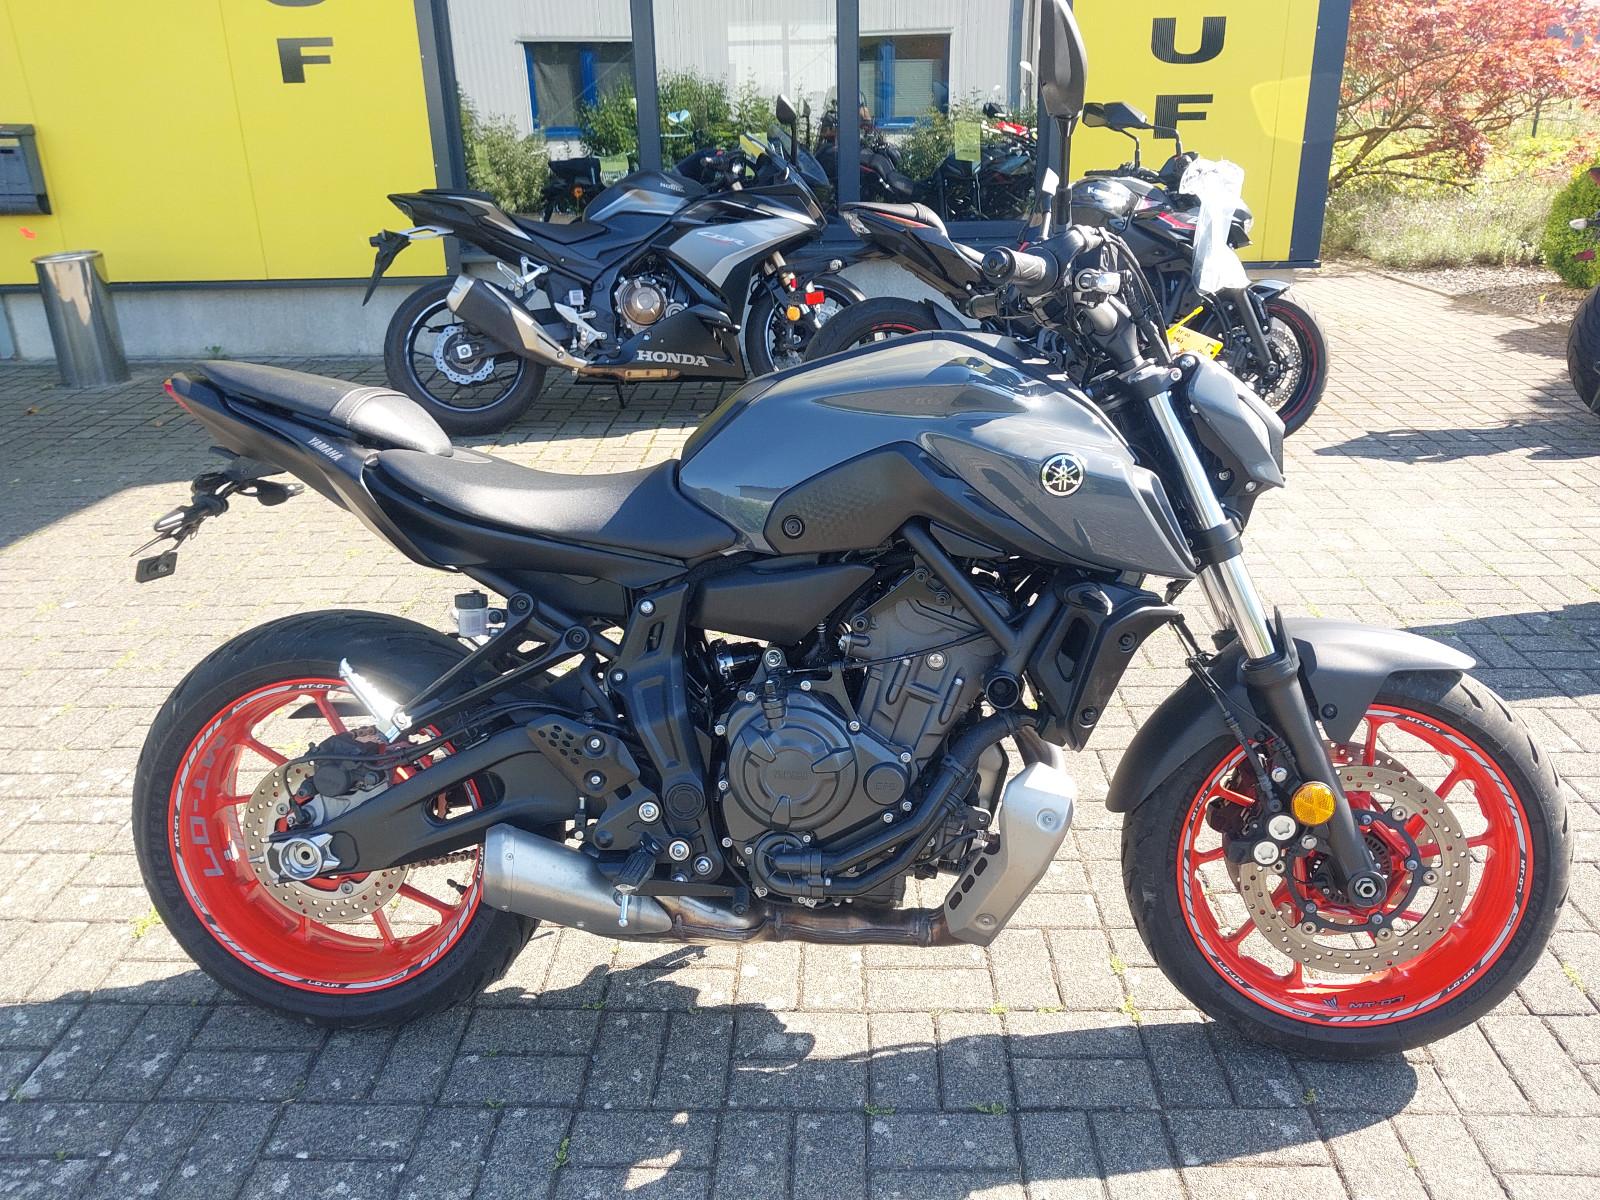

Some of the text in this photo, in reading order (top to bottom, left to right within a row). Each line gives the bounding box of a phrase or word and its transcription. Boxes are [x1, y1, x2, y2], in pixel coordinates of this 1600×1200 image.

[660, 183, 685, 193] HONDA
[637, 350, 709, 367] HONDA
[308, 436, 343, 461] YAMAHA
[1405, 716, 1440, 732] MT-07
[190, 735, 226, 876] MT-07
[1191, 790, 1208, 821] MT-07
[1517, 859, 1525, 892] MT-07
[308, 979, 340, 988] MT-07
[1217, 961, 1244, 984] MT-07
[1447, 968, 1475, 992] MT-07
[1349, 995, 1406, 1009] MT-07
